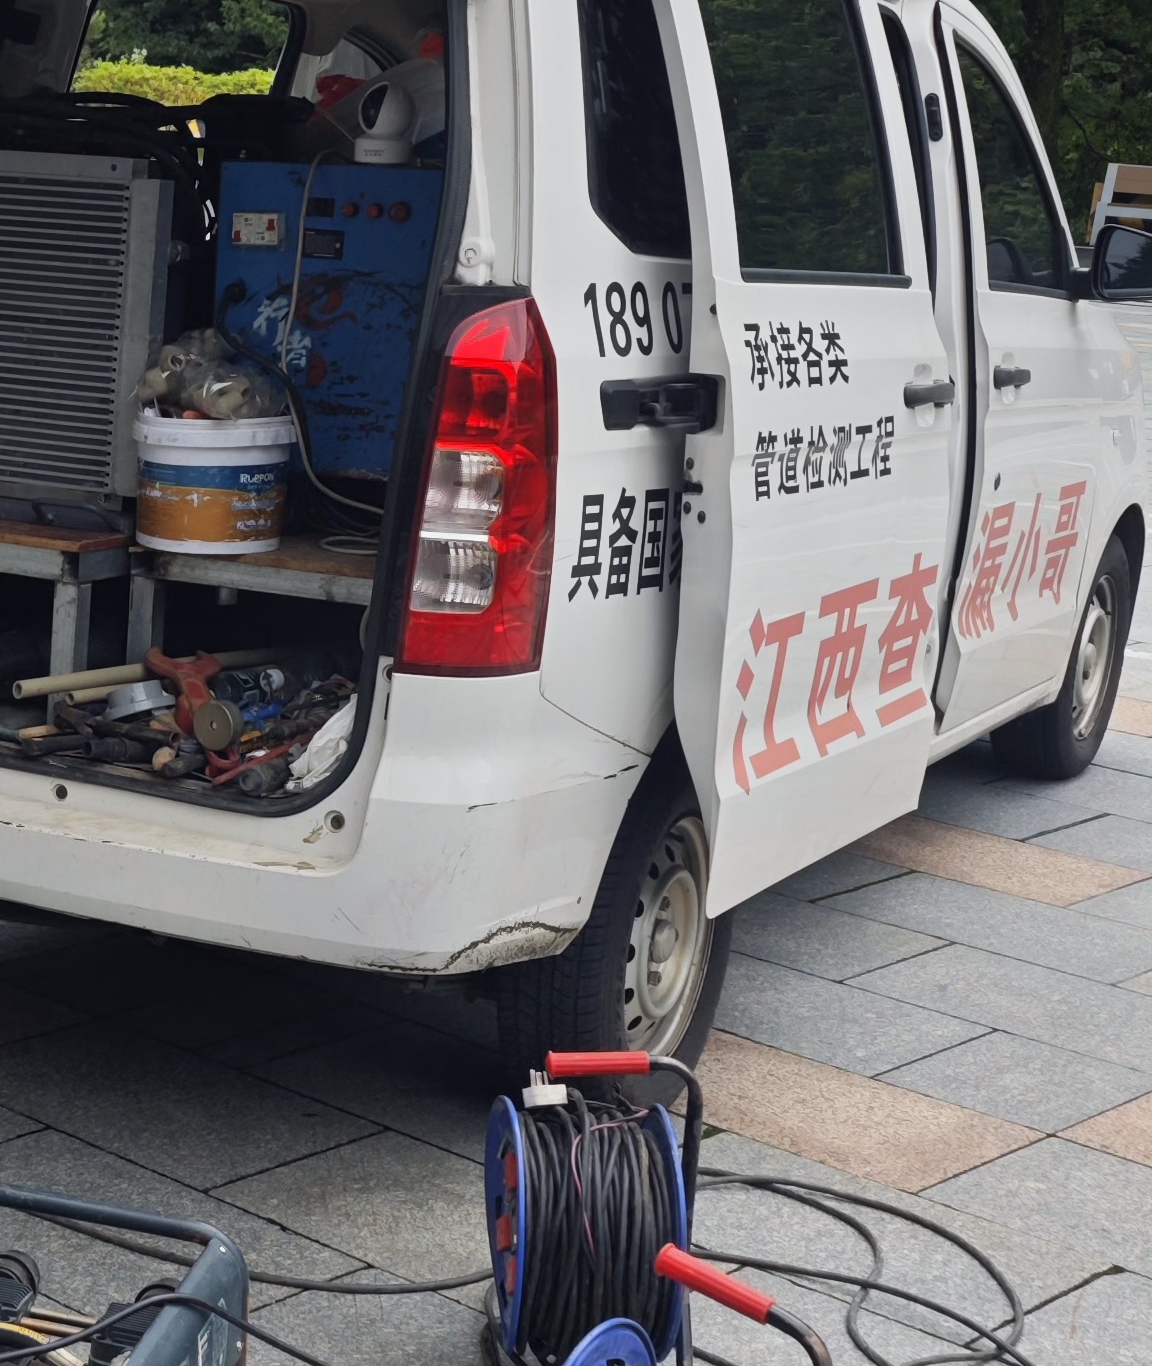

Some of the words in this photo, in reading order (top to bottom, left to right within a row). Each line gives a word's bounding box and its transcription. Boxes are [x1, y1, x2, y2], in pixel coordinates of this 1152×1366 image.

[583, 281, 651, 357] 189
[743, 320, 850, 392] 承接各类
[750, 415, 896, 502] 管道检测工程
